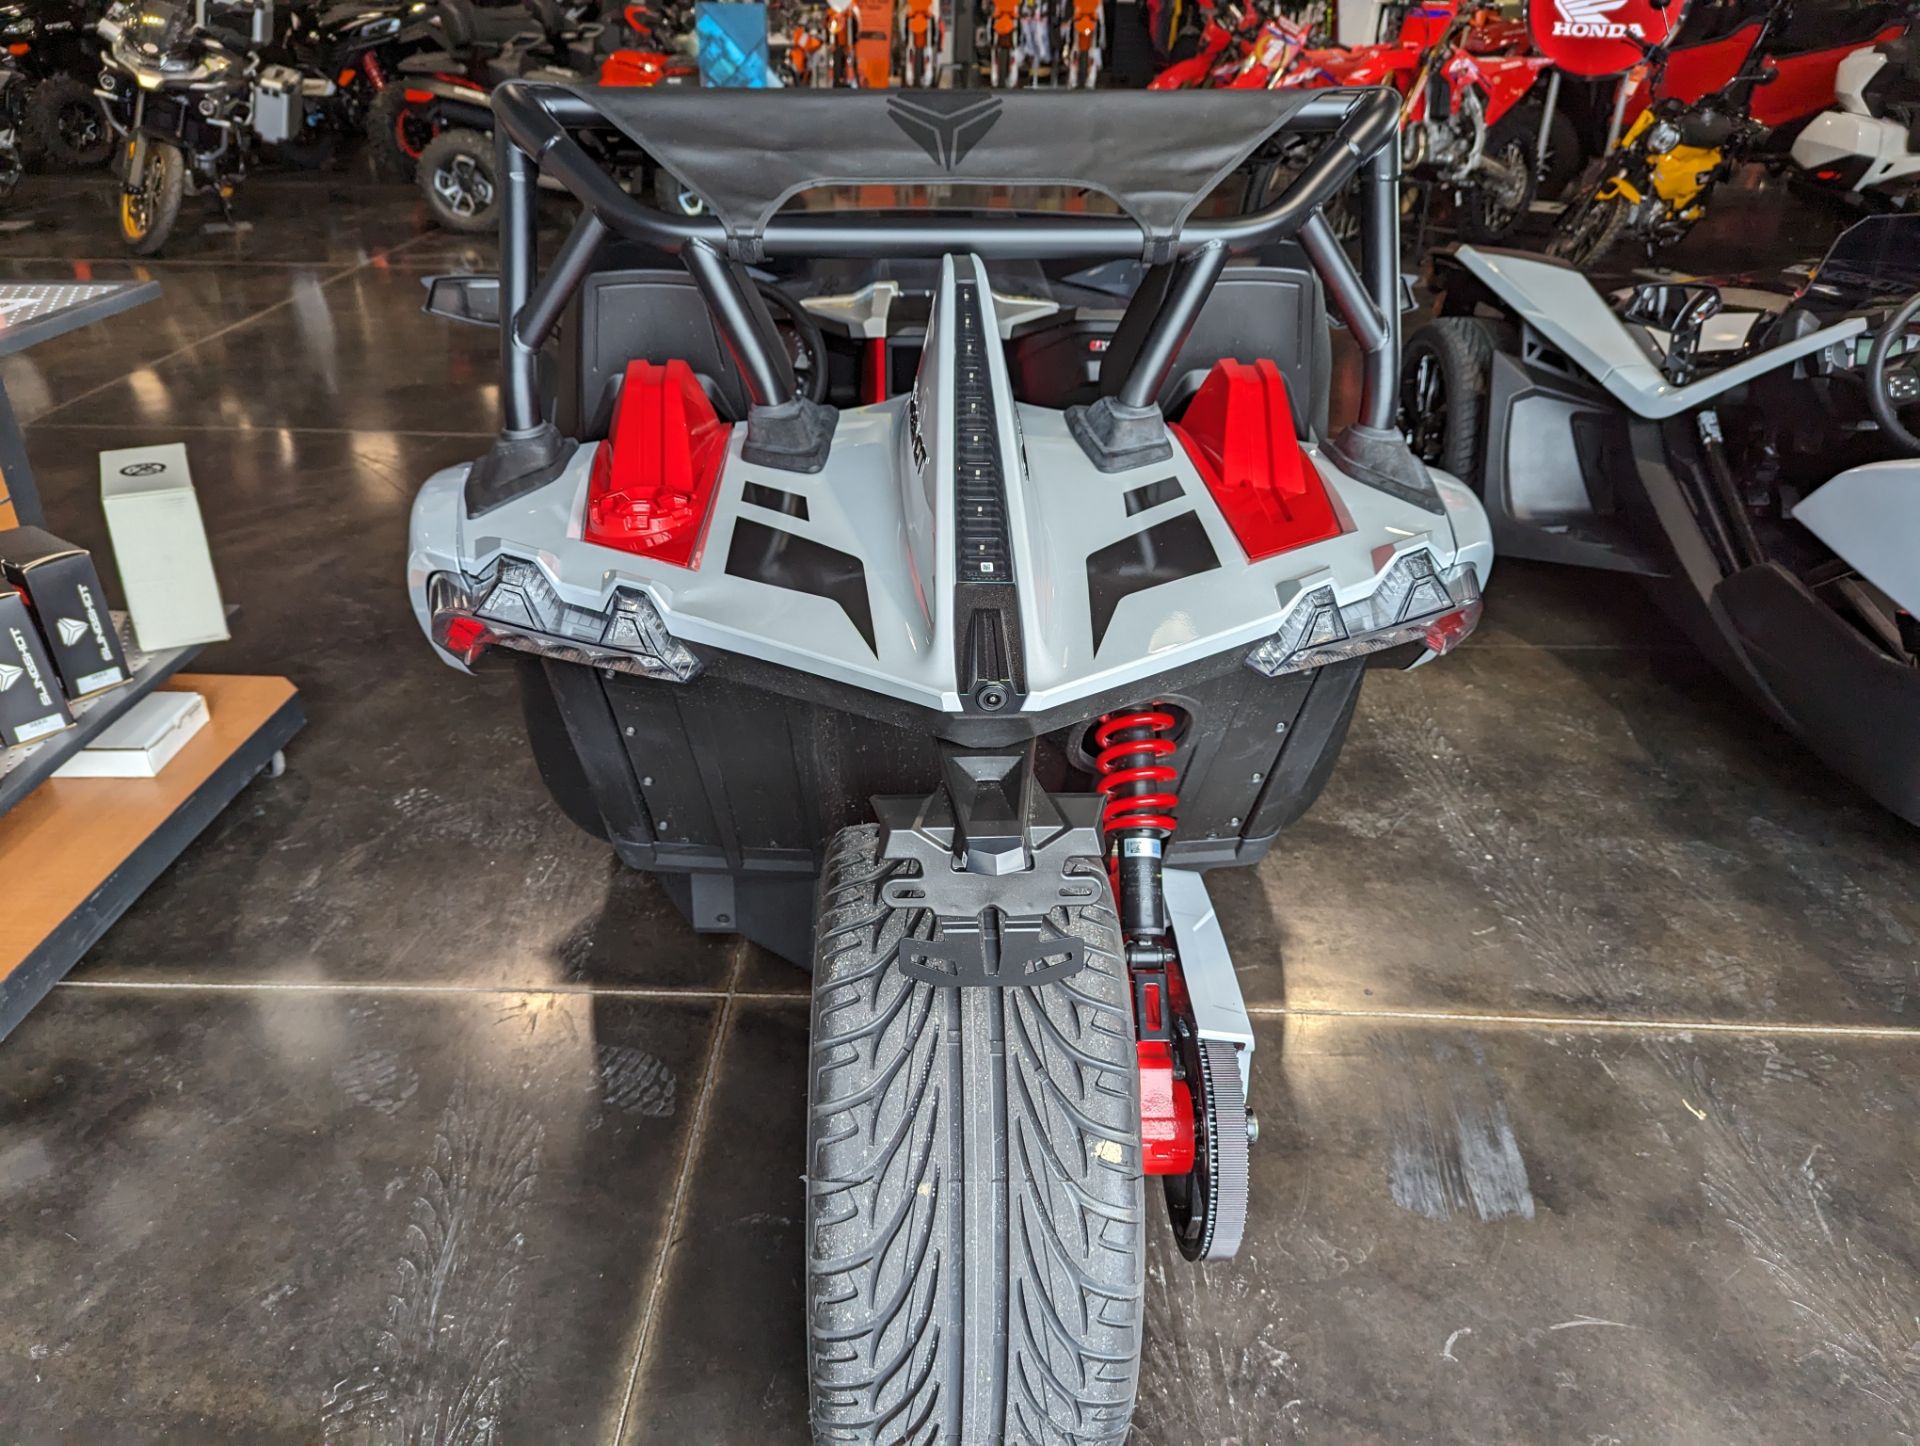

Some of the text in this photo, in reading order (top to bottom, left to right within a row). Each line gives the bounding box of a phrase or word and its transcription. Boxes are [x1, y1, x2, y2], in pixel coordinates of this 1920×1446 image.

[1552, 21, 1646, 38] HONDA
[77, 584, 113, 661] SLINGSHOT
[9, 627, 52, 706] SLINGSHOT
